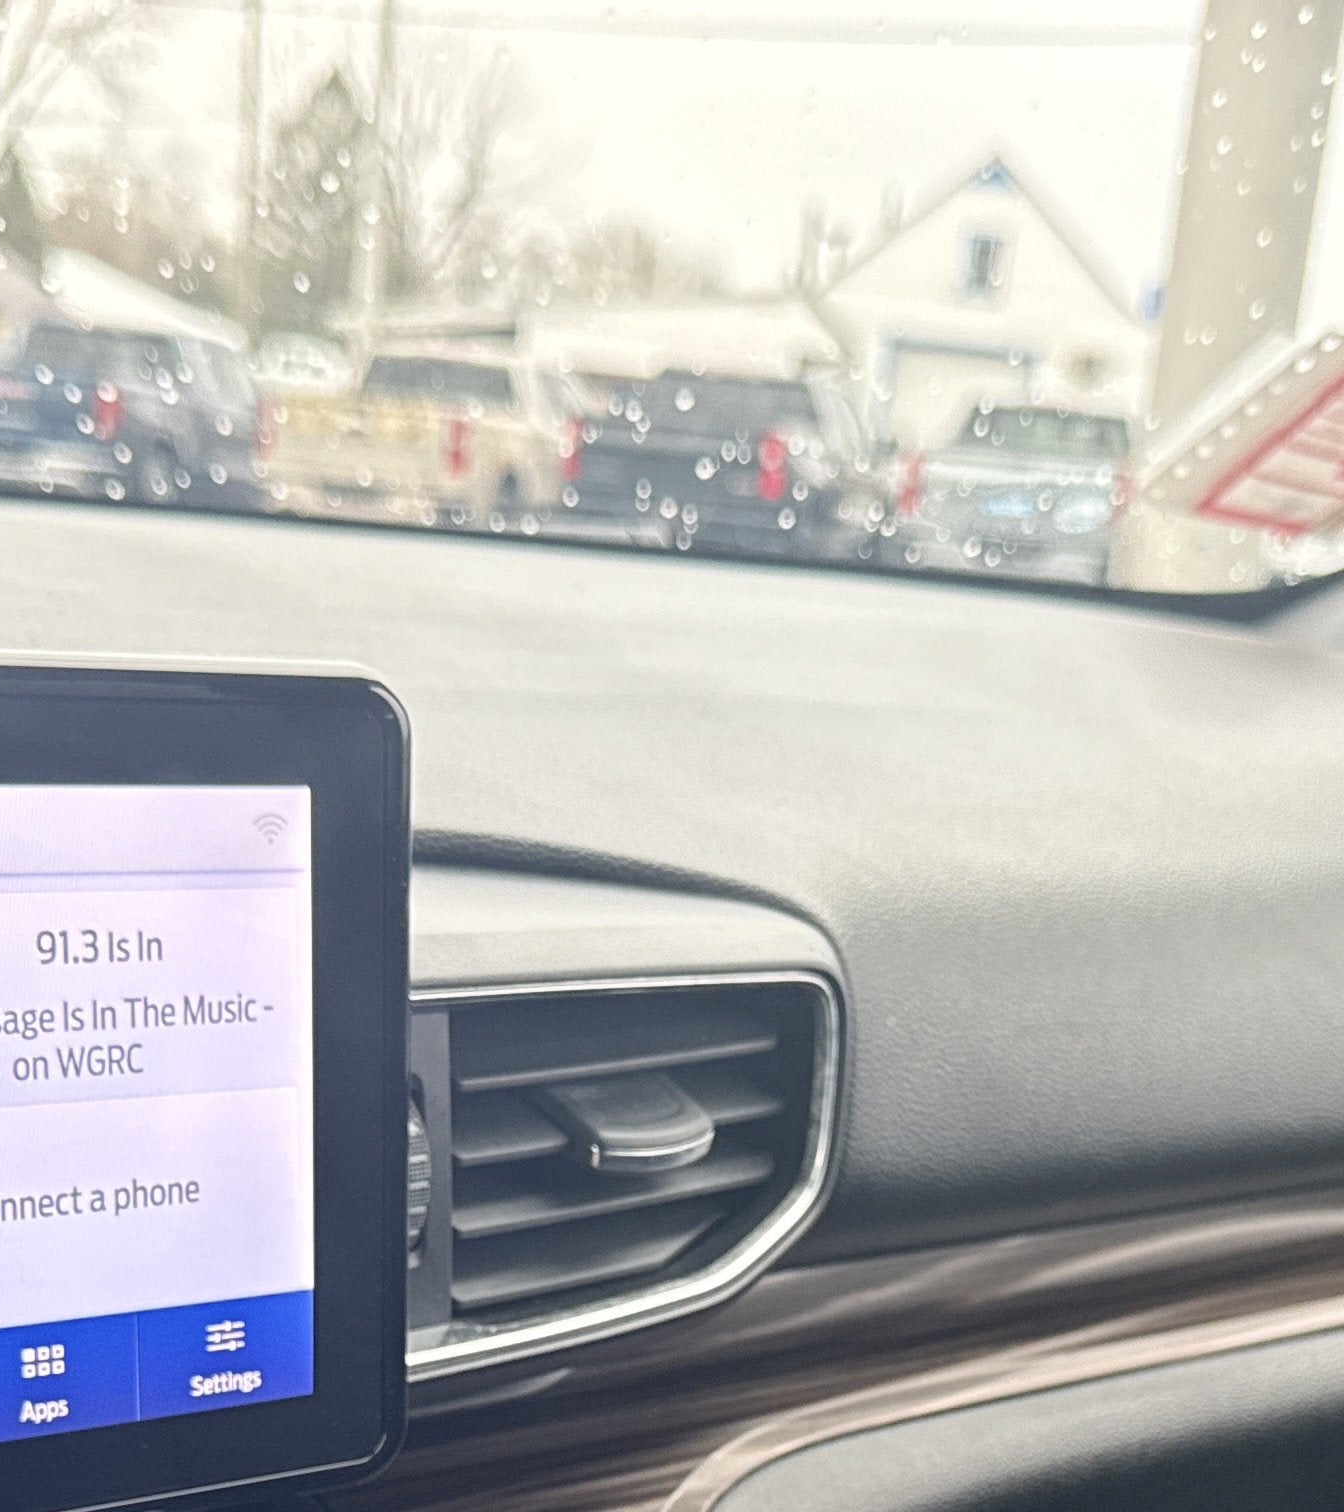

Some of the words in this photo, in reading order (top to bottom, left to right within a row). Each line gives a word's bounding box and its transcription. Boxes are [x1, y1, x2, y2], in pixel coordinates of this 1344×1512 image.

[35, 930, 99, 964] 91.3
[107, 930, 130, 963] Is
[138, 929, 163, 962] In
[63, 1001, 85, 1032] Is
[92, 998, 116, 1030] In
[123, 996, 175, 1029] The
[183, 993, 257, 1024] Music
[13, 1054, 49, 1081] on
[56, 1044, 144, 1079] WGRC
[90, 1188, 106, 1212] a
[114, 1177, 200, 1216] phone
[189, 1369, 262, 1397] Settings
[19, 1399, 69, 1424] Apps
